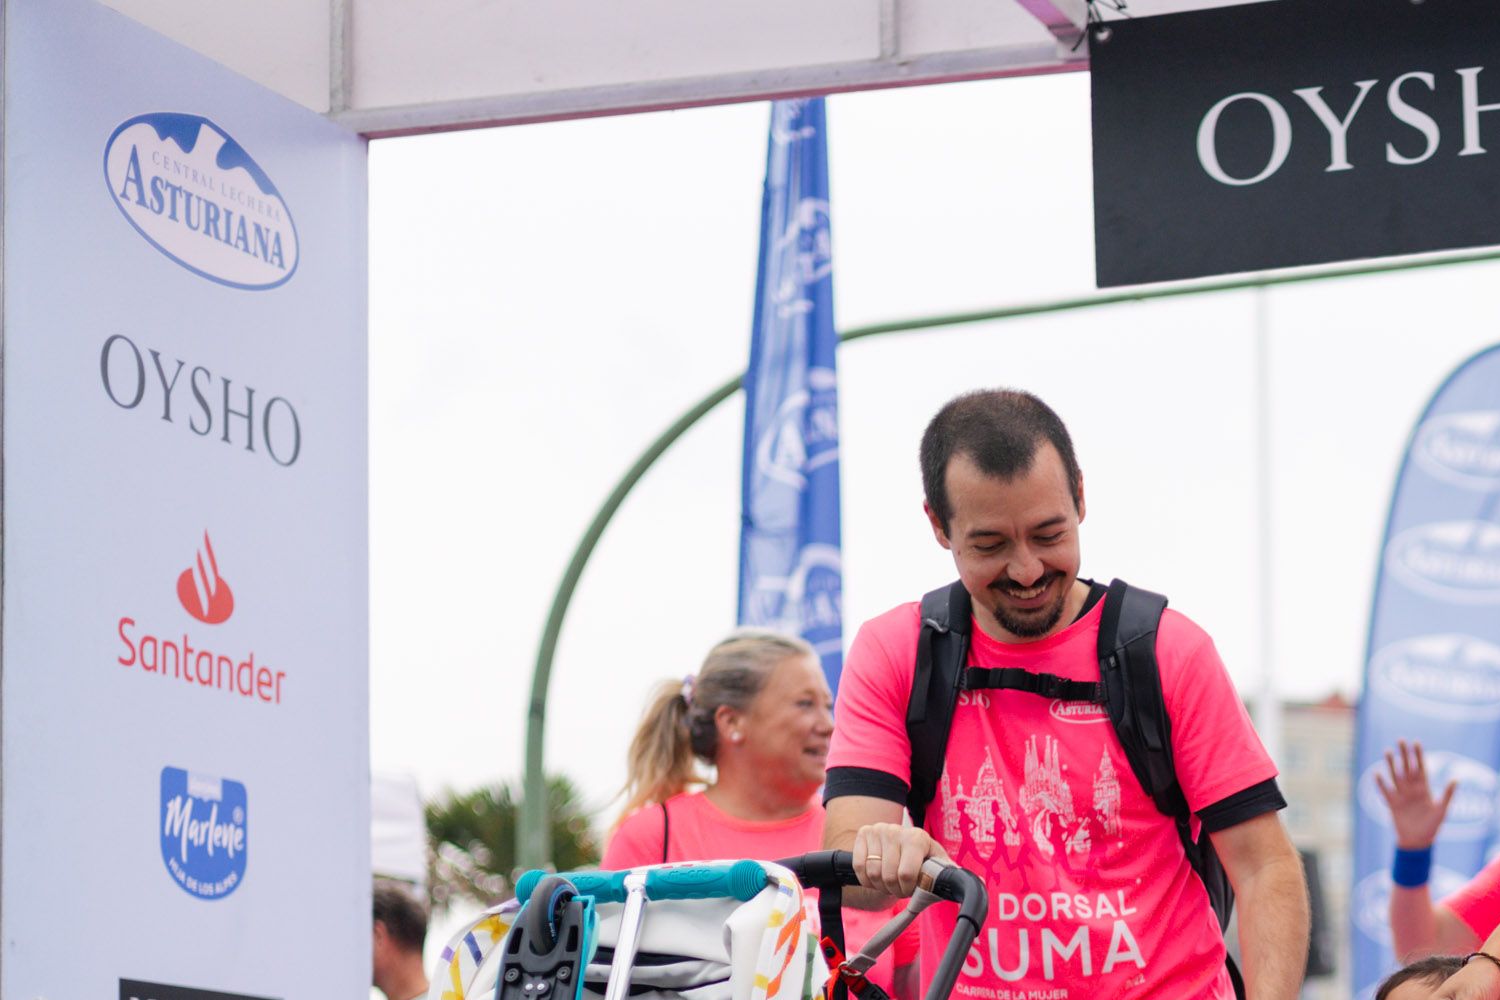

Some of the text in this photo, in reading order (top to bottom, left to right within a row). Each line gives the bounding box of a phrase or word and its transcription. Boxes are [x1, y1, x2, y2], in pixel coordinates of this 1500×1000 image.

[151, 150, 215, 192] CENTRAL
[119, 144, 287, 270] ASTURIANA
[101, 334, 301, 467] OYSHO
[117, 617, 286, 704] Santander
[164, 795, 244, 863] Marlene
[999, 889, 1137, 922] DORSAL
[960, 919, 1147, 982] SUMA
[997, 989, 1011, 1000] DE
[1028, 988, 1069, 1000] MUJER
